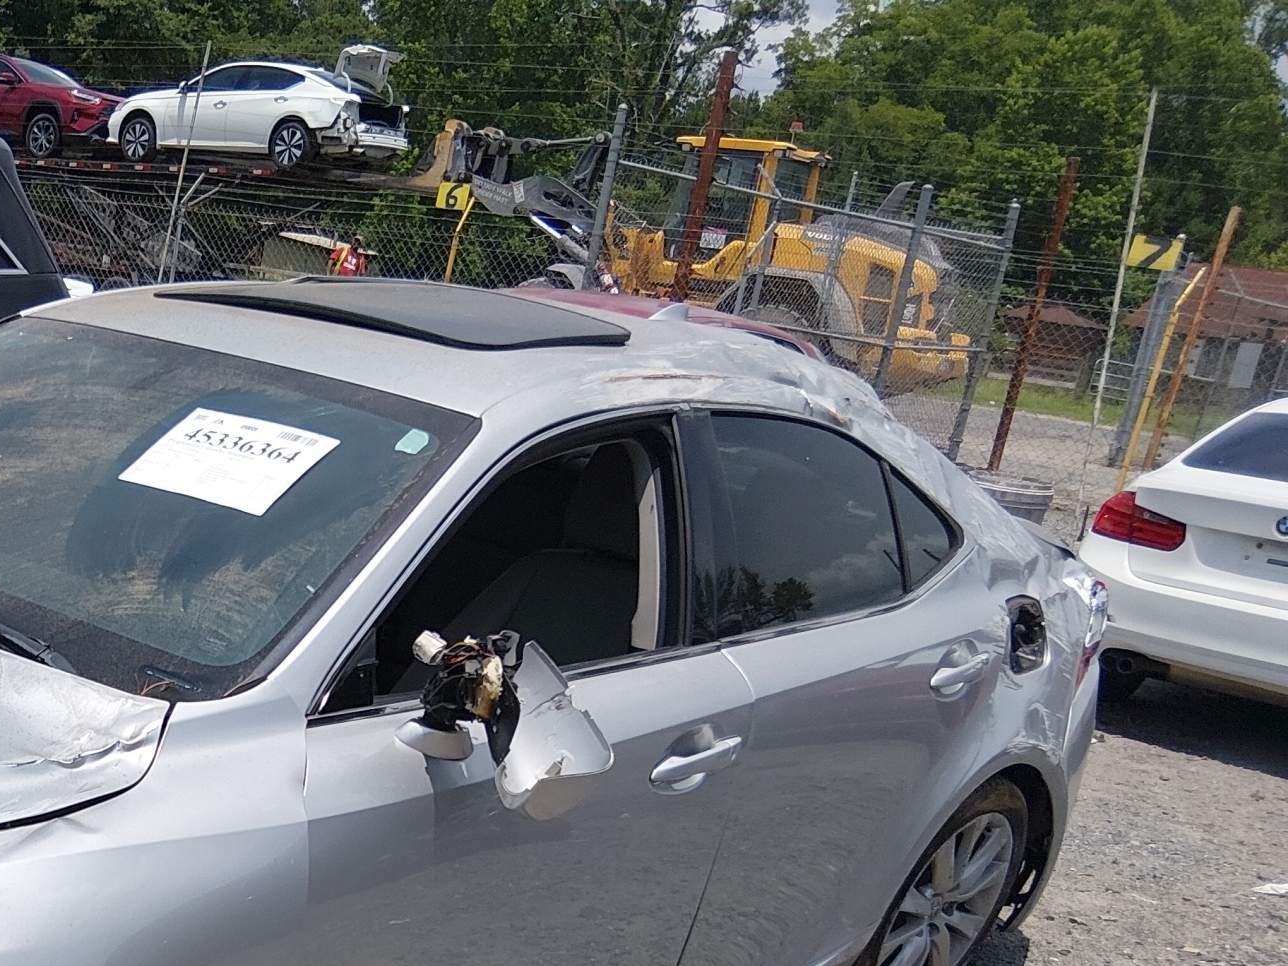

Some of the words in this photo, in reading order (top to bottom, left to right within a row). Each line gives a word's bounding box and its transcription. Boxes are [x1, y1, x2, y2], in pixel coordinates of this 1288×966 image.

[445, 184, 464, 208] 6
[1137, 234, 1173, 269] 7
[184, 427, 302, 464] 45336364
